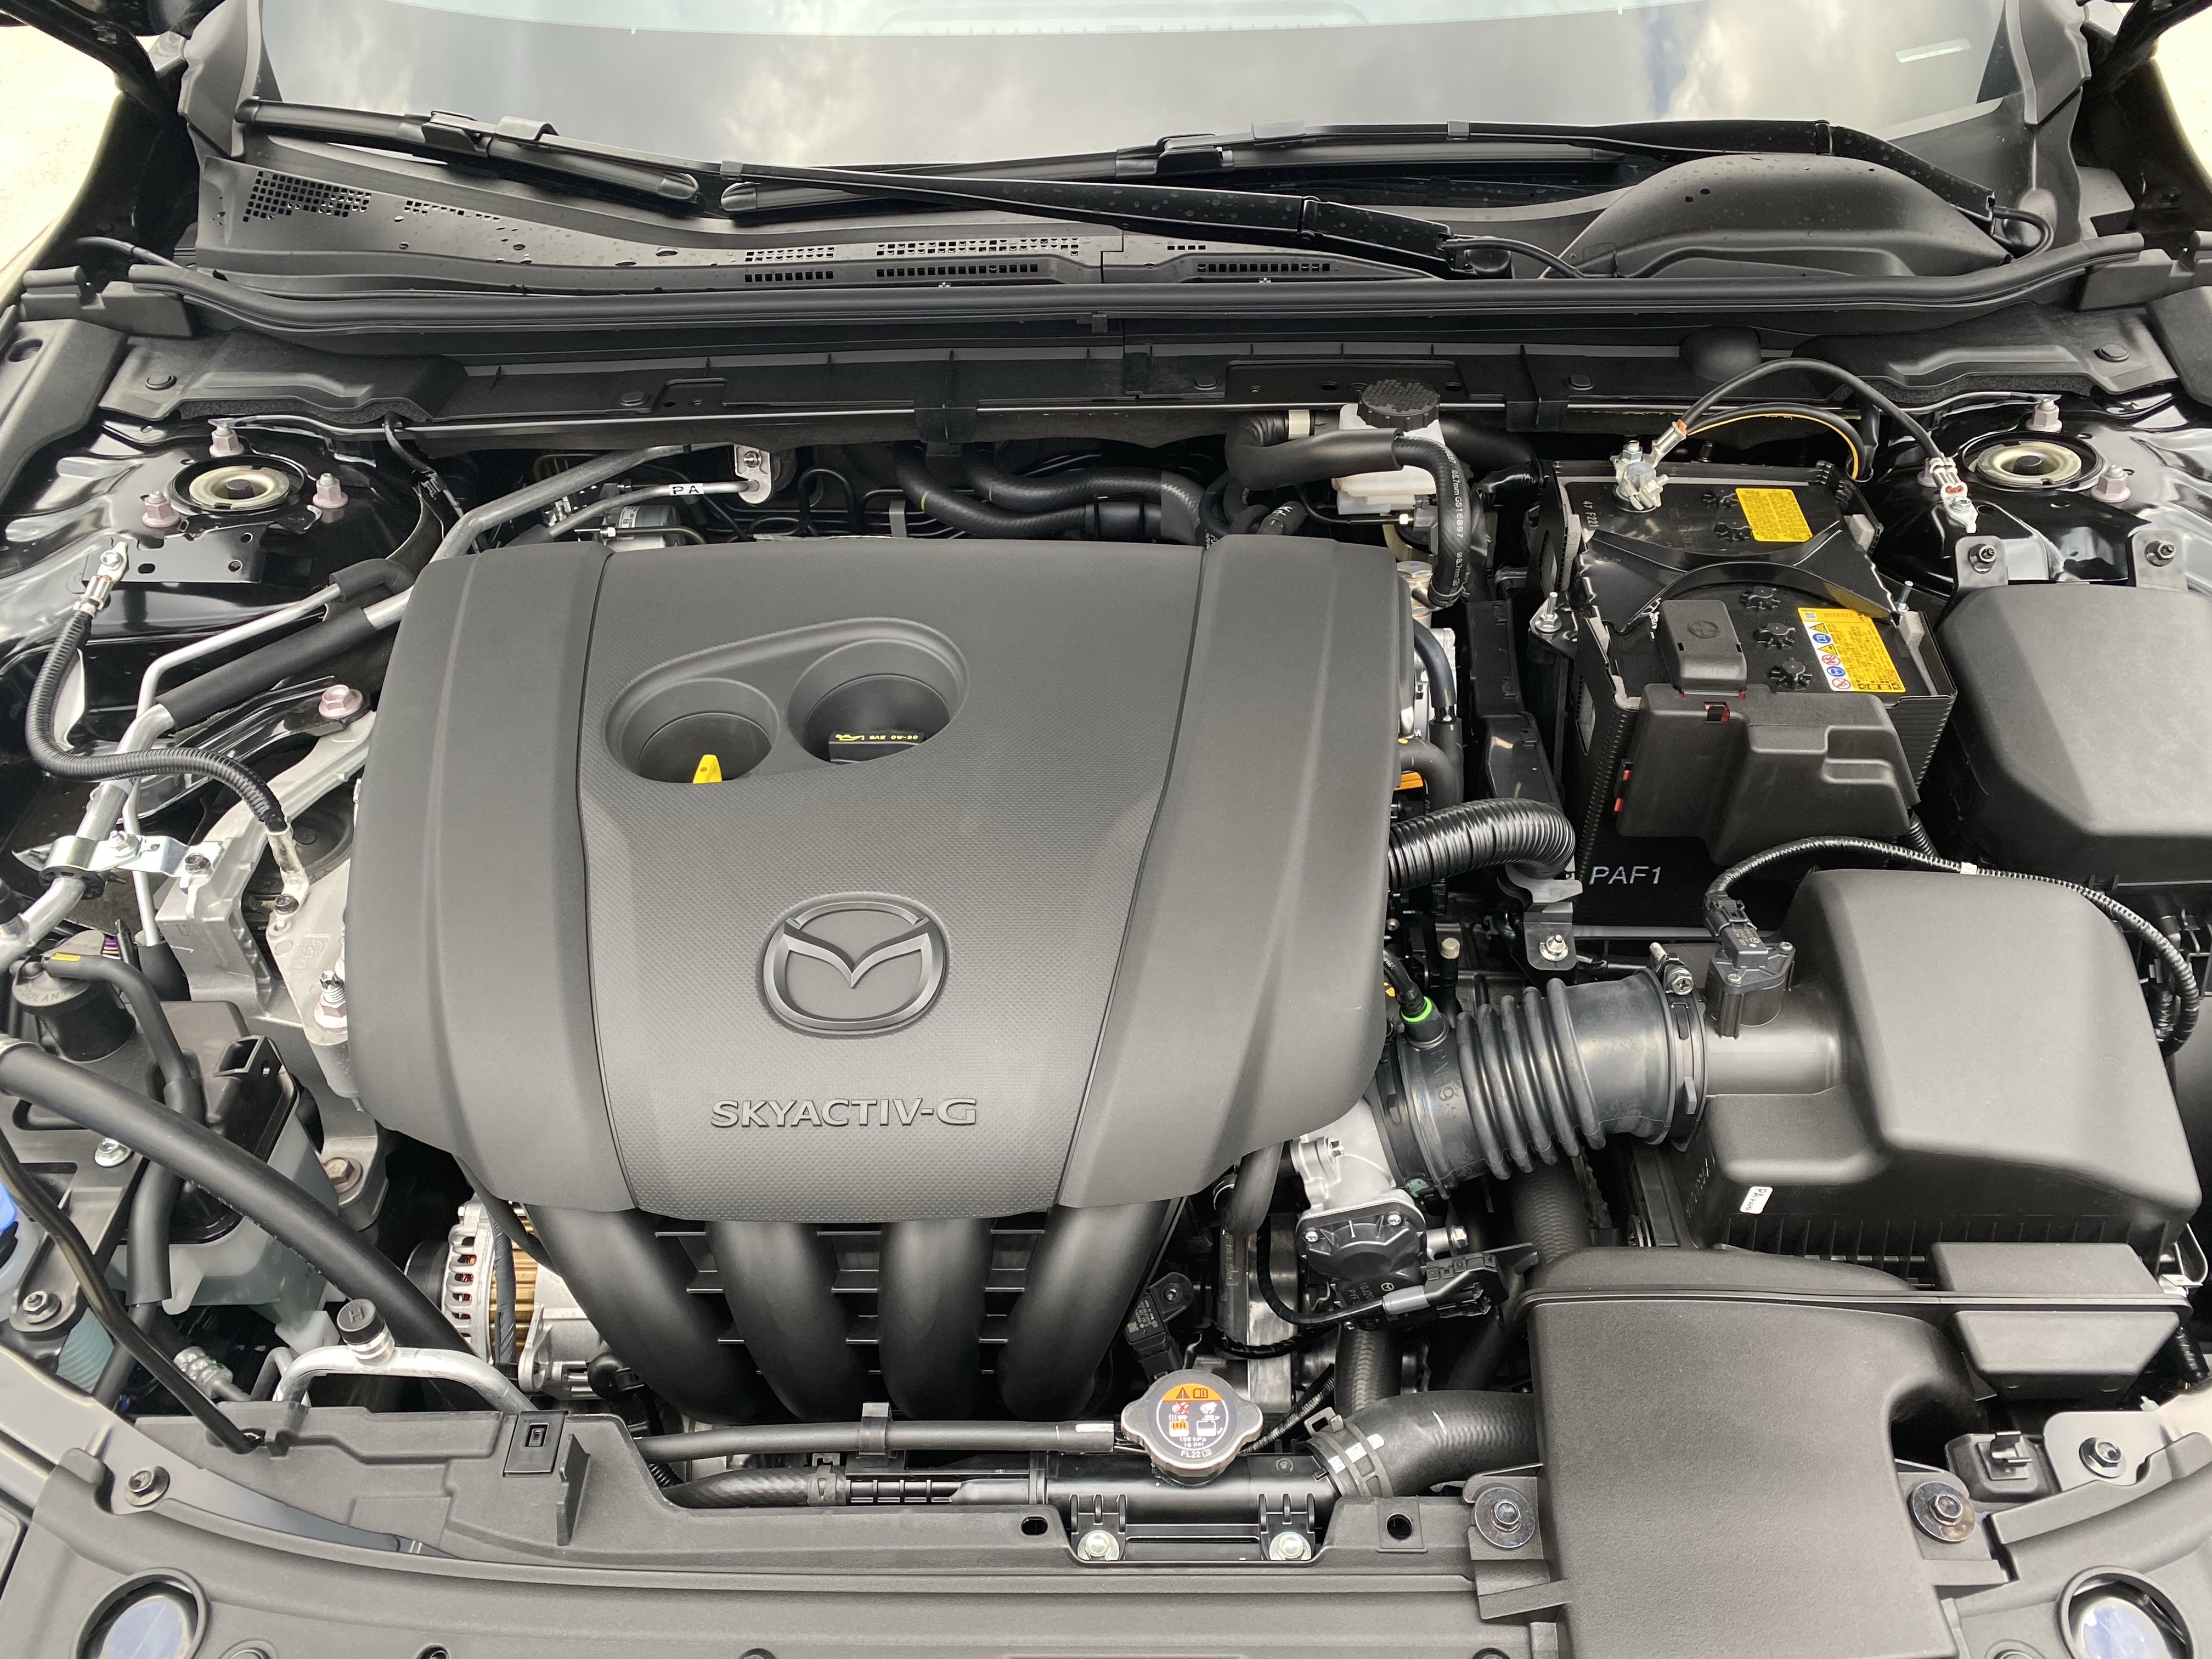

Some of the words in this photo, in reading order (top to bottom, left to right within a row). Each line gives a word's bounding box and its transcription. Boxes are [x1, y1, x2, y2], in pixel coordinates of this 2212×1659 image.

[672, 486, 699, 495] PA
[1454, 496, 1464, 538] GB16897
[1585, 512, 1600, 527] F221
[1589, 866, 1661, 885] PAF1
[710, 1098, 977, 1127] SKYACTIV-G
[1752, 1188, 1767, 1197] PA
[348, 1306, 365, 1323] H
[1181, 1450, 1201, 1458] FL22
